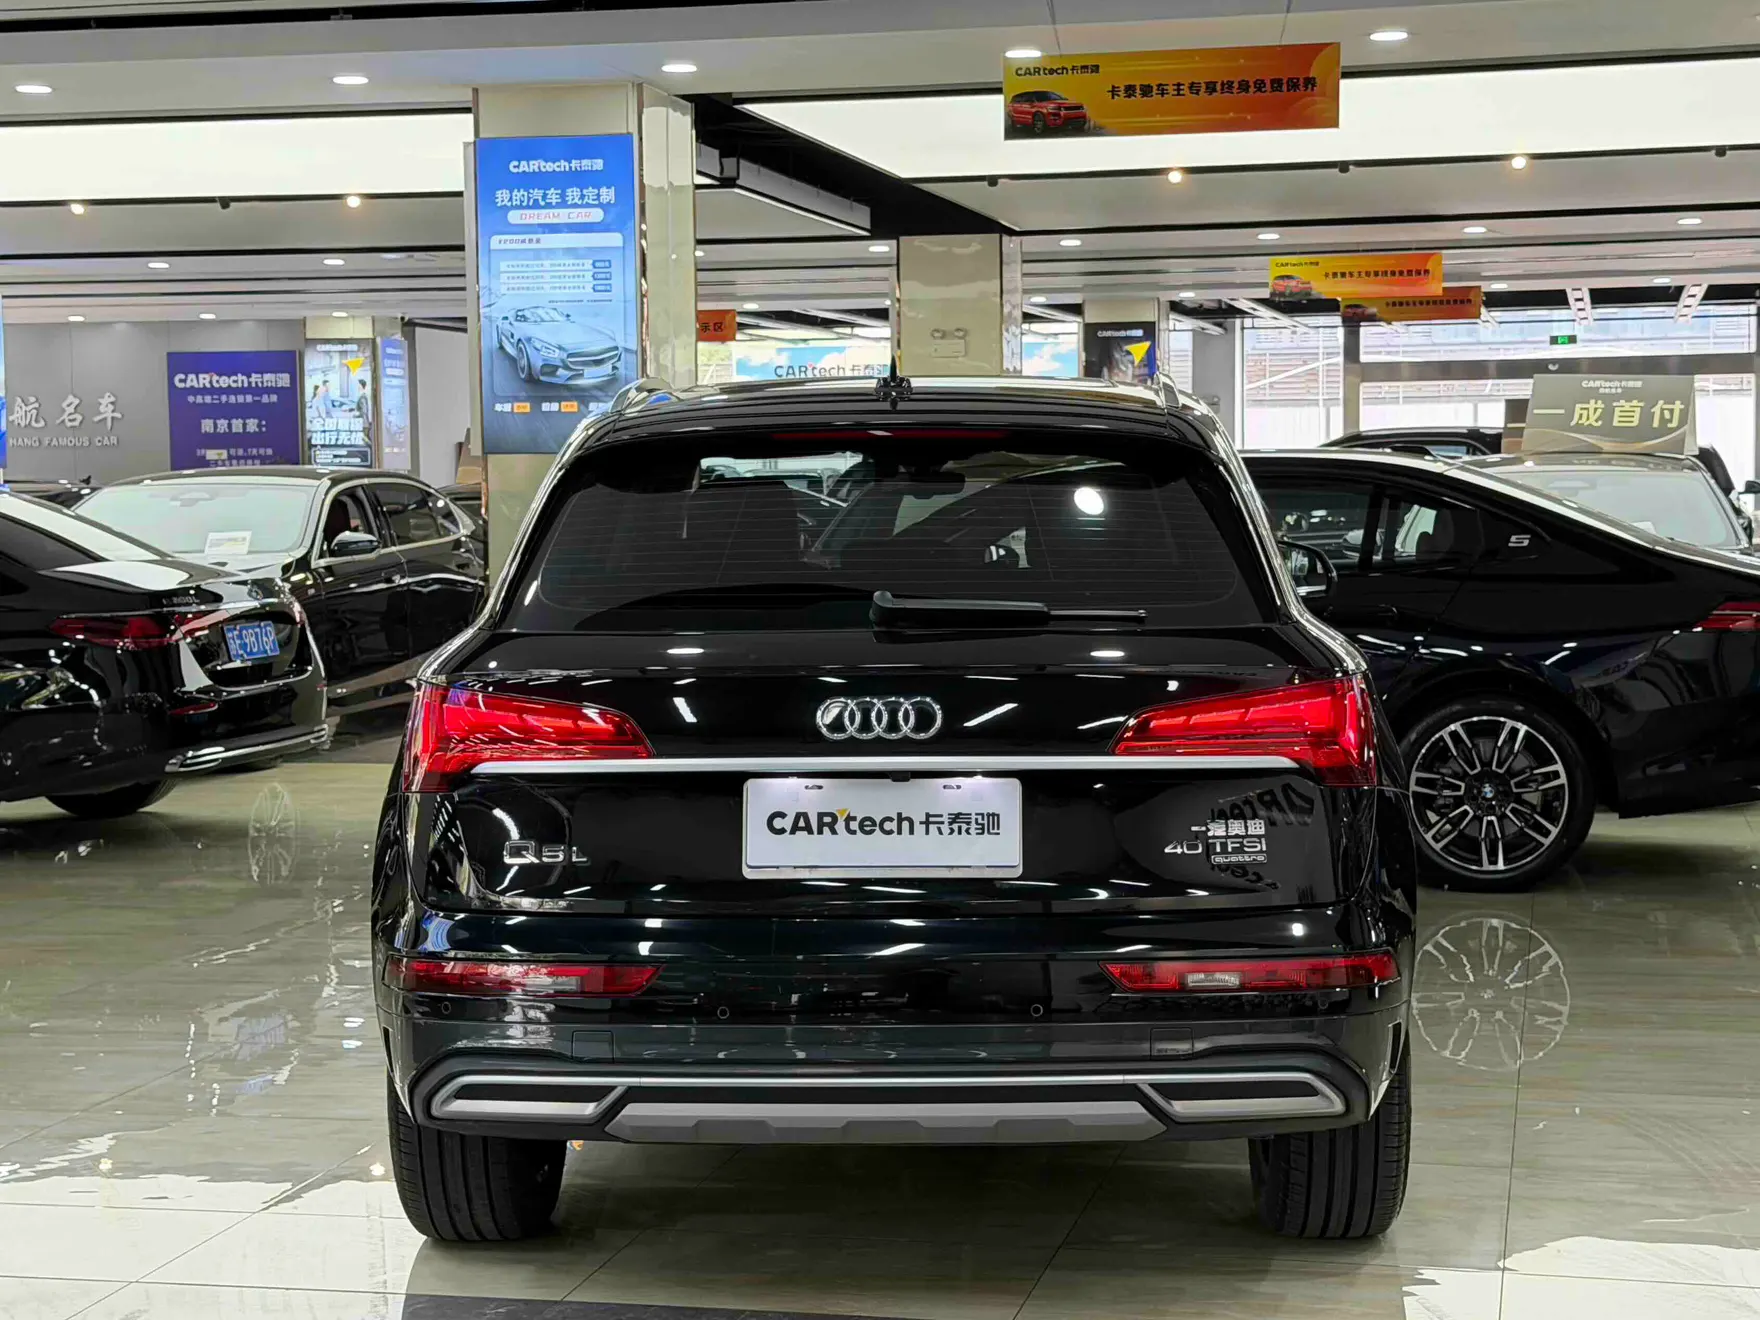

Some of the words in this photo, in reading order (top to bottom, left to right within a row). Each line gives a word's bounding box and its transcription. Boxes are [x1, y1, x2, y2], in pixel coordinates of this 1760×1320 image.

[1015, 66, 1069, 77] CARtech
[1106, 76, 1318, 100] 卡泰驰车主专享终身免费保养
[509, 159, 569, 173] CARtech
[495, 187, 562, 207] 我的汽车
[565, 186, 616, 206] 我定制
[519, 212, 561, 221] DREAM
[567, 211, 593, 220] CAR
[701, 322, 725, 333] 示区
[773, 365, 846, 378] CARtech
[173, 373, 248, 389] CARtech
[1532, 399, 1685, 428] 一成首付
[9, 436, 40, 447] HANG
[44, 436, 90, 447] FAMOUS
[95, 435, 119, 447] CAR
[766, 809, 914, 836] CARtech
[919, 811, 1001, 836] 卡泰驰
[502, 840, 588, 865] Q5L
[1164, 840, 1203, 855] 40
[1208, 837, 1267, 853] TFSI
[1213, 854, 1266, 863] quattro
